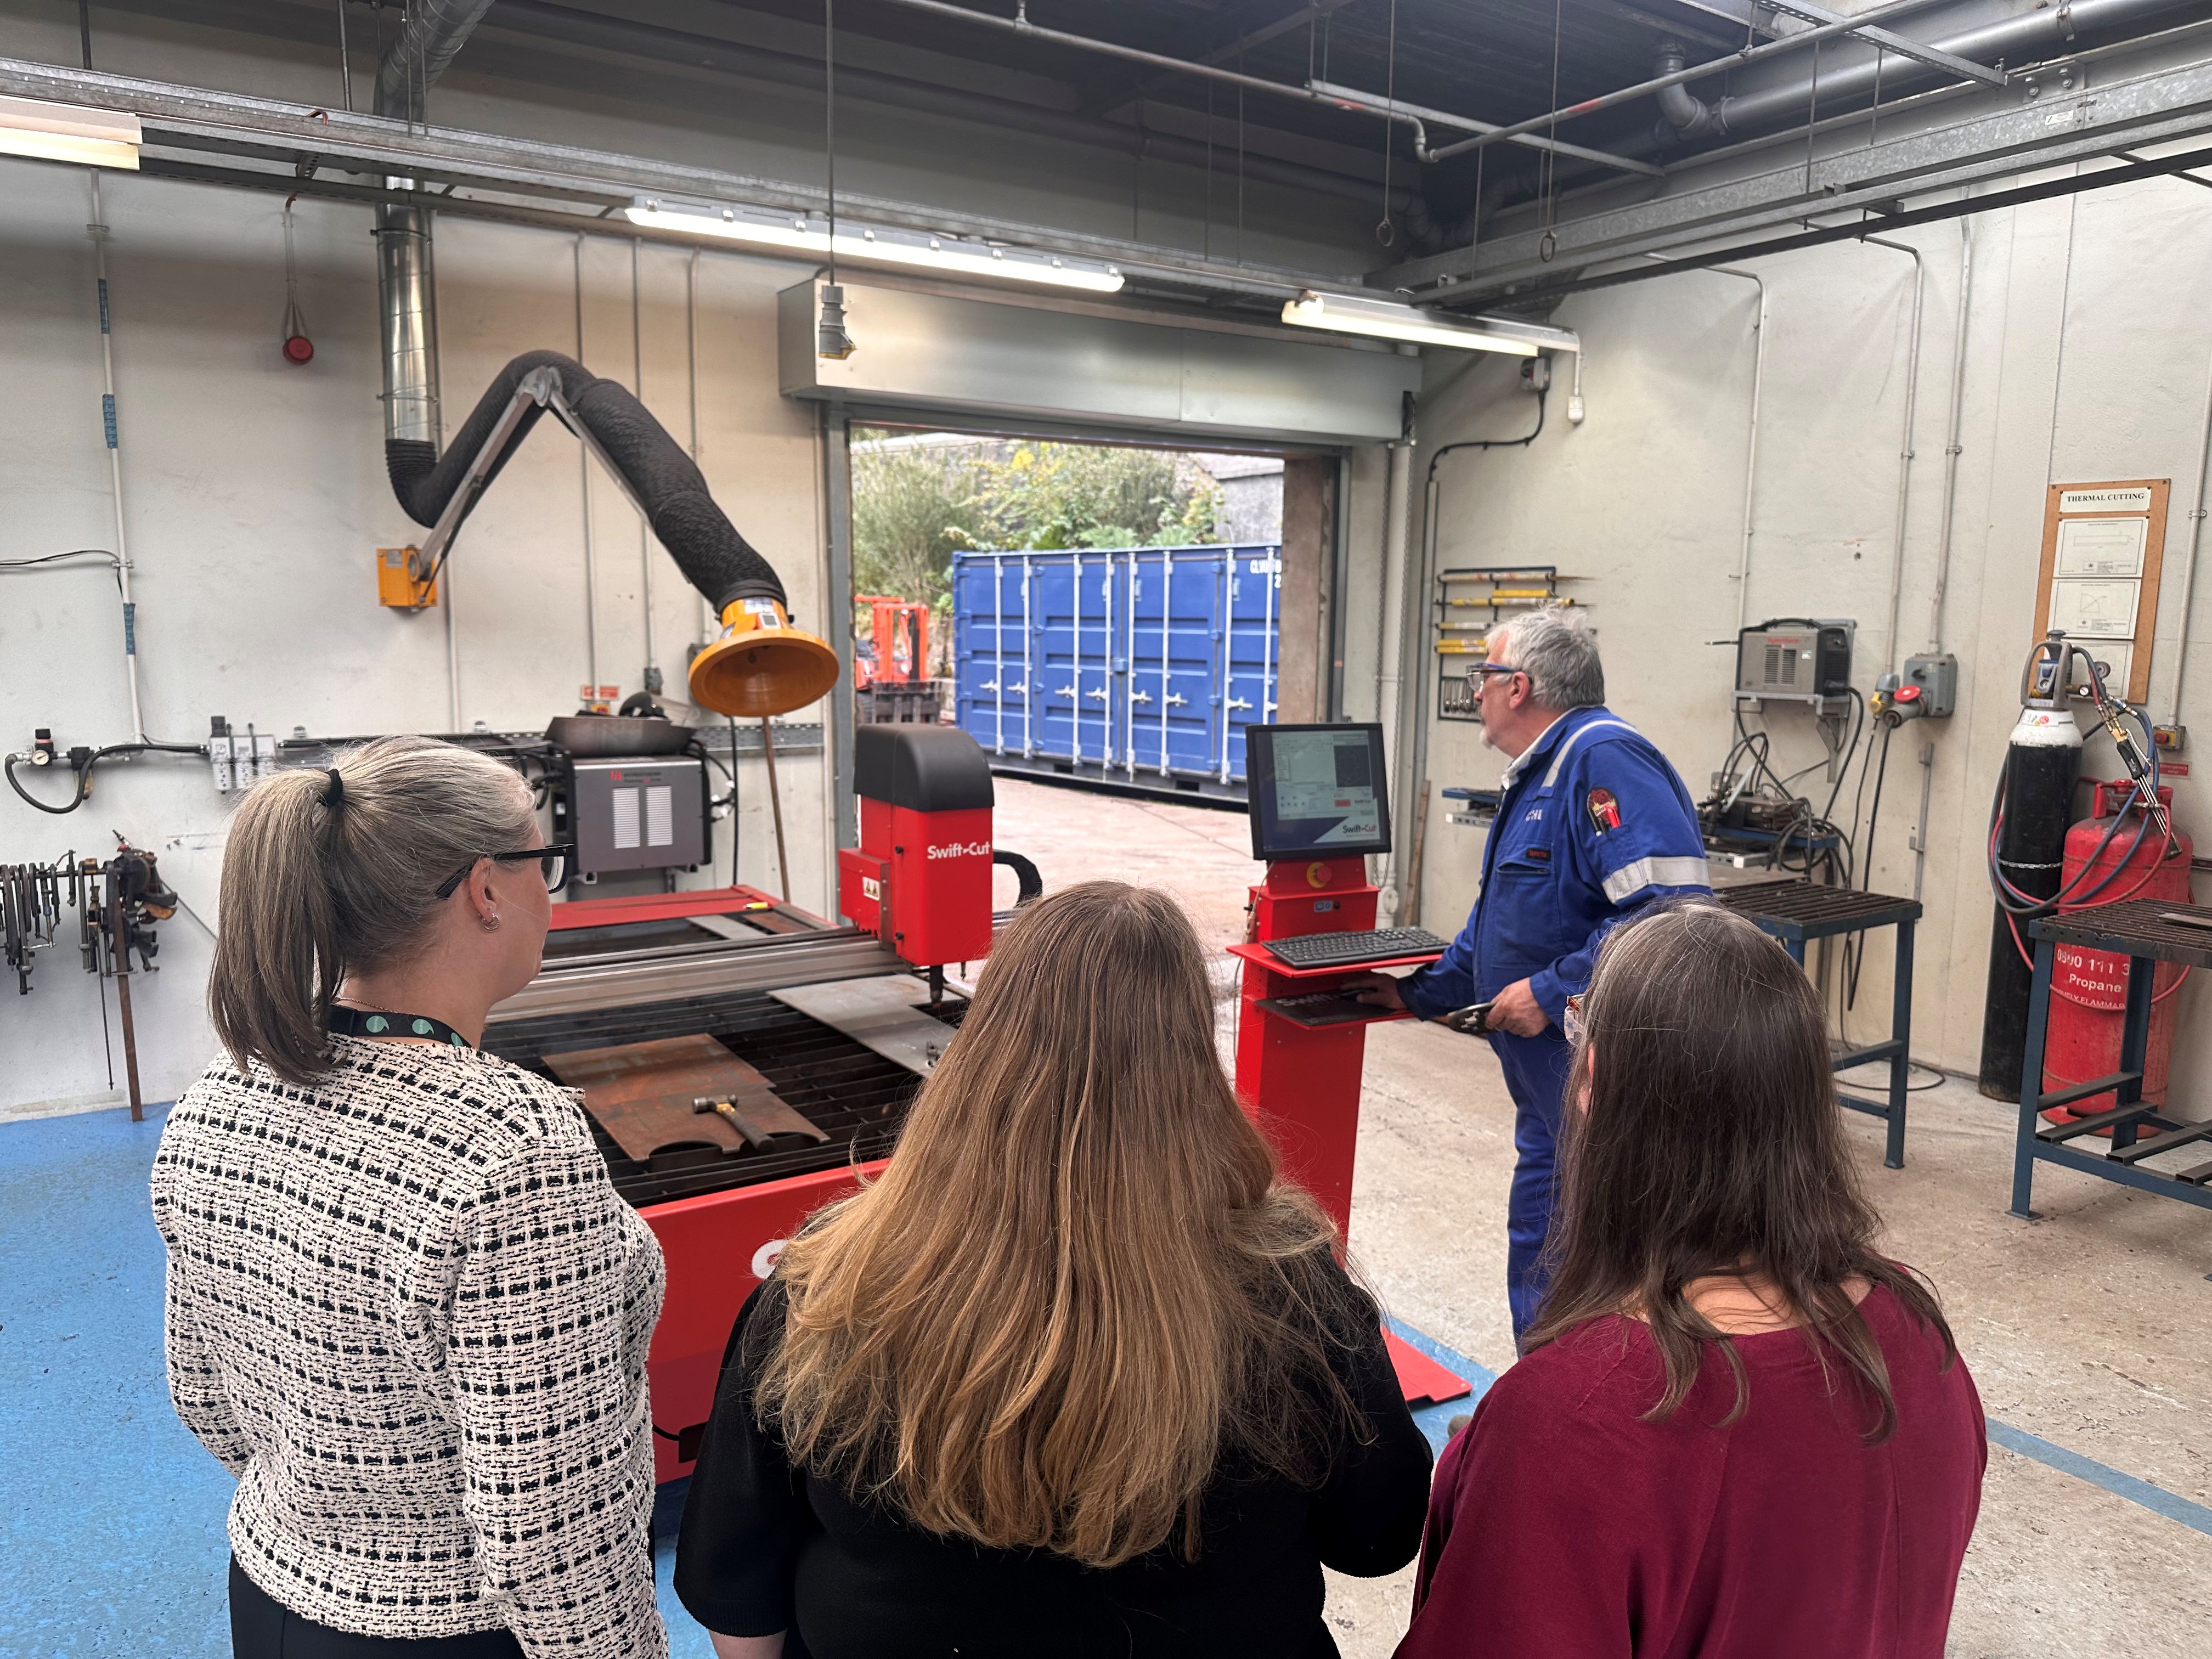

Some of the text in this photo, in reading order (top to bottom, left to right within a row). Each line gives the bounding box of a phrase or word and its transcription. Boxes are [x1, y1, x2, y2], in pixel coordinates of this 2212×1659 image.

[1342, 824, 1376, 833] Swift-Cut
[927, 841, 990, 860] Swift-Cut
[2069, 973, 2121, 993] Propane
